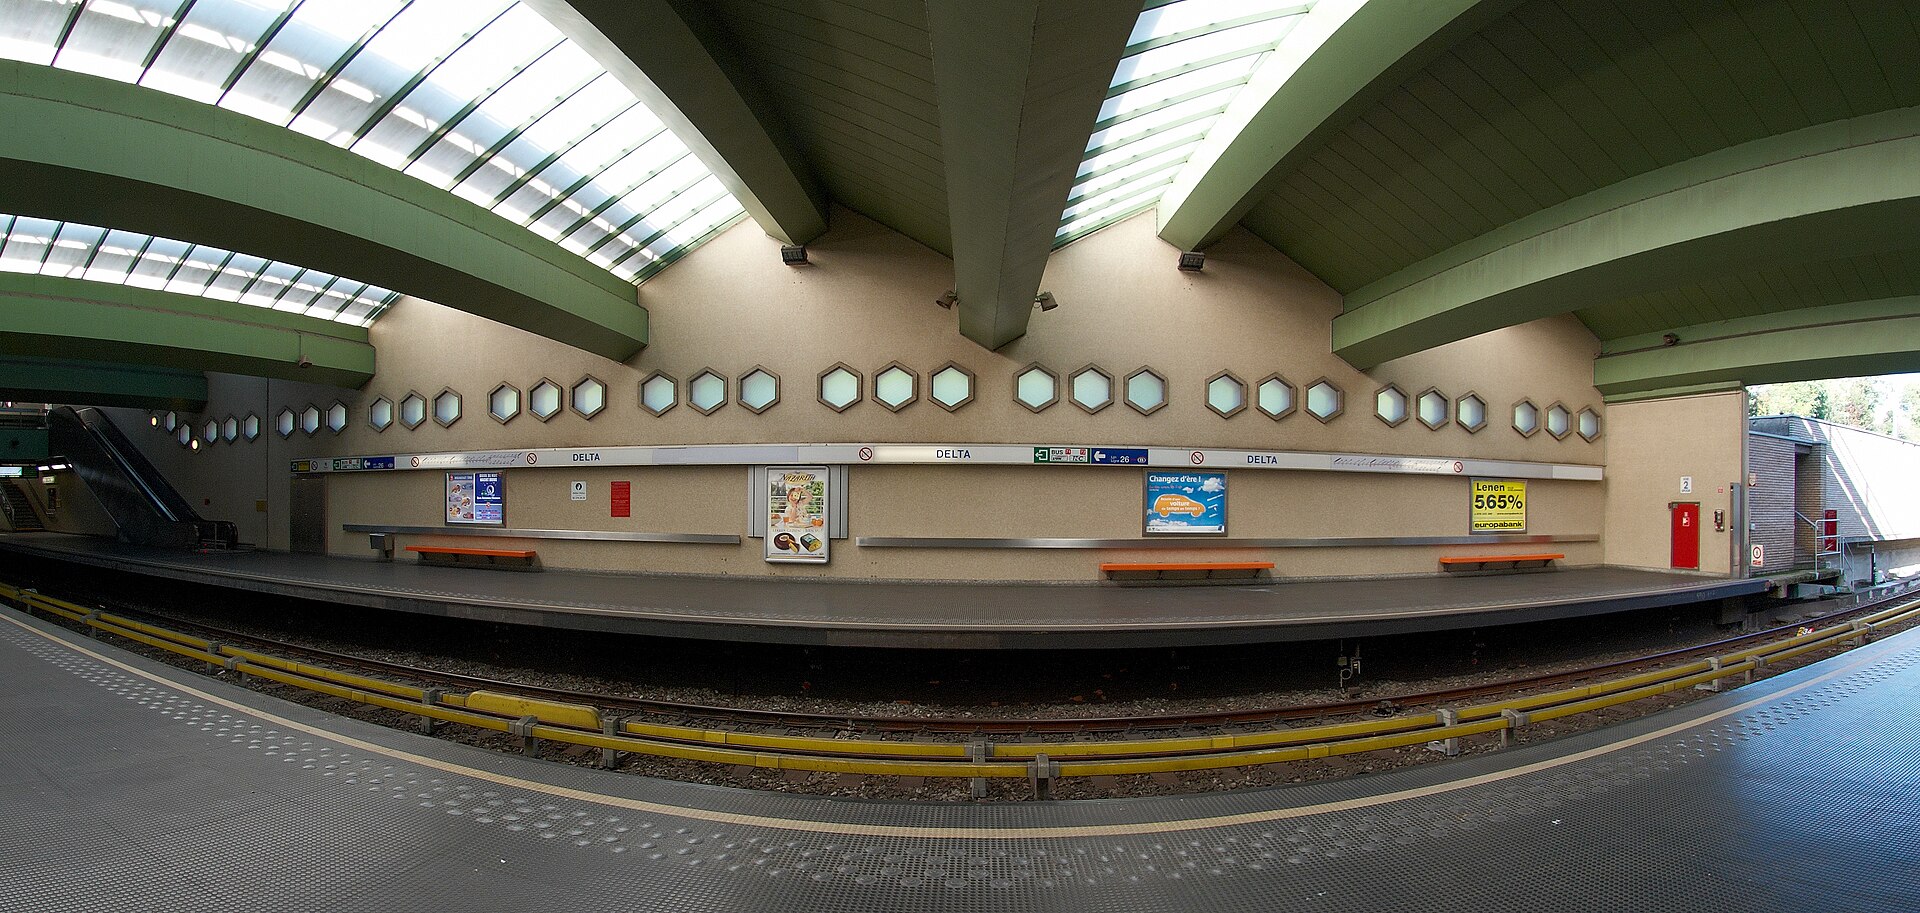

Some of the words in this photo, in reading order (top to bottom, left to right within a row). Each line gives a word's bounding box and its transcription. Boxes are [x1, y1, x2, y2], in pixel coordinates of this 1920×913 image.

[572, 453, 600, 462] DELTA
[936, 449, 971, 459] DELTA
[1120, 455, 1130, 464] 26
[1247, 455, 1278, 464] DELTA
[1149, 475, 1179, 484] Changez
[1180, 475, 1197, 483] d'ère
[1476, 482, 1505, 491] Lenen
[1683, 481, 1689, 490] 2
[1474, 494, 1523, 510] 5,65%
[1474, 521, 1522, 529] europabank
